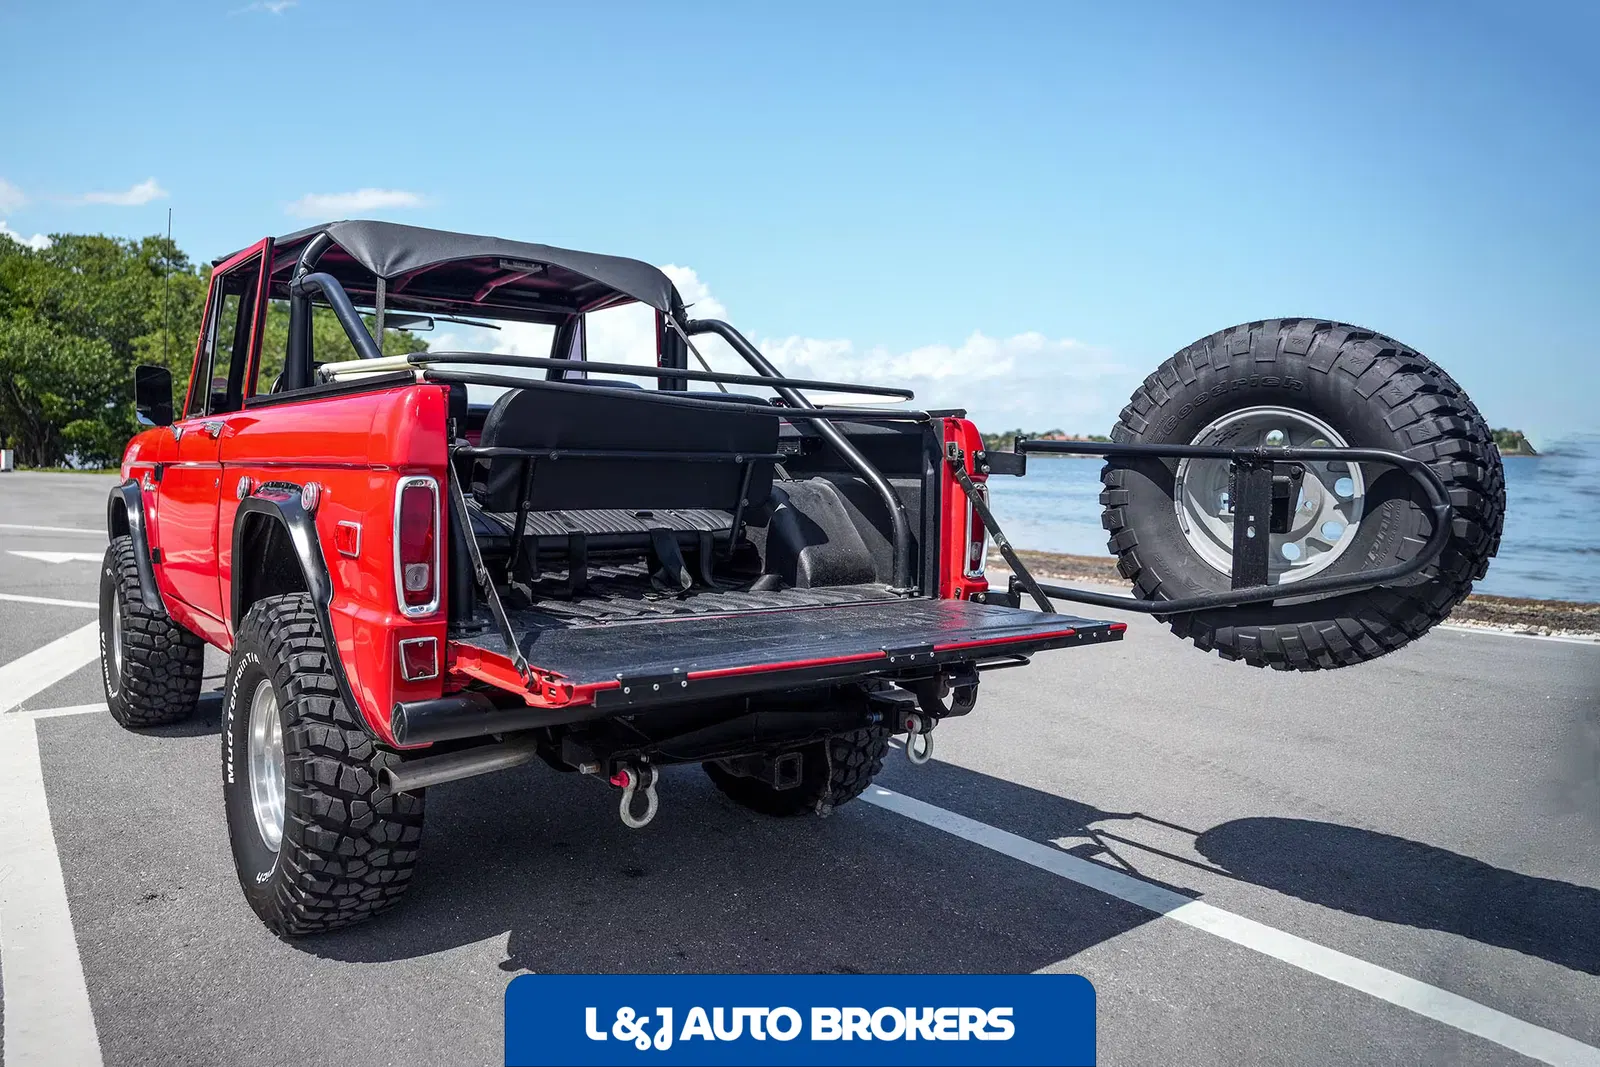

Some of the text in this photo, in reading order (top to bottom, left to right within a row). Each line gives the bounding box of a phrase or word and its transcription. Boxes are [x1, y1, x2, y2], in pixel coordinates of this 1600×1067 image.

[1155, 373, 1304, 444] Goodrich
[227, 657, 248, 784] Mud-Terrain
[246, 652, 260, 665] T/A
